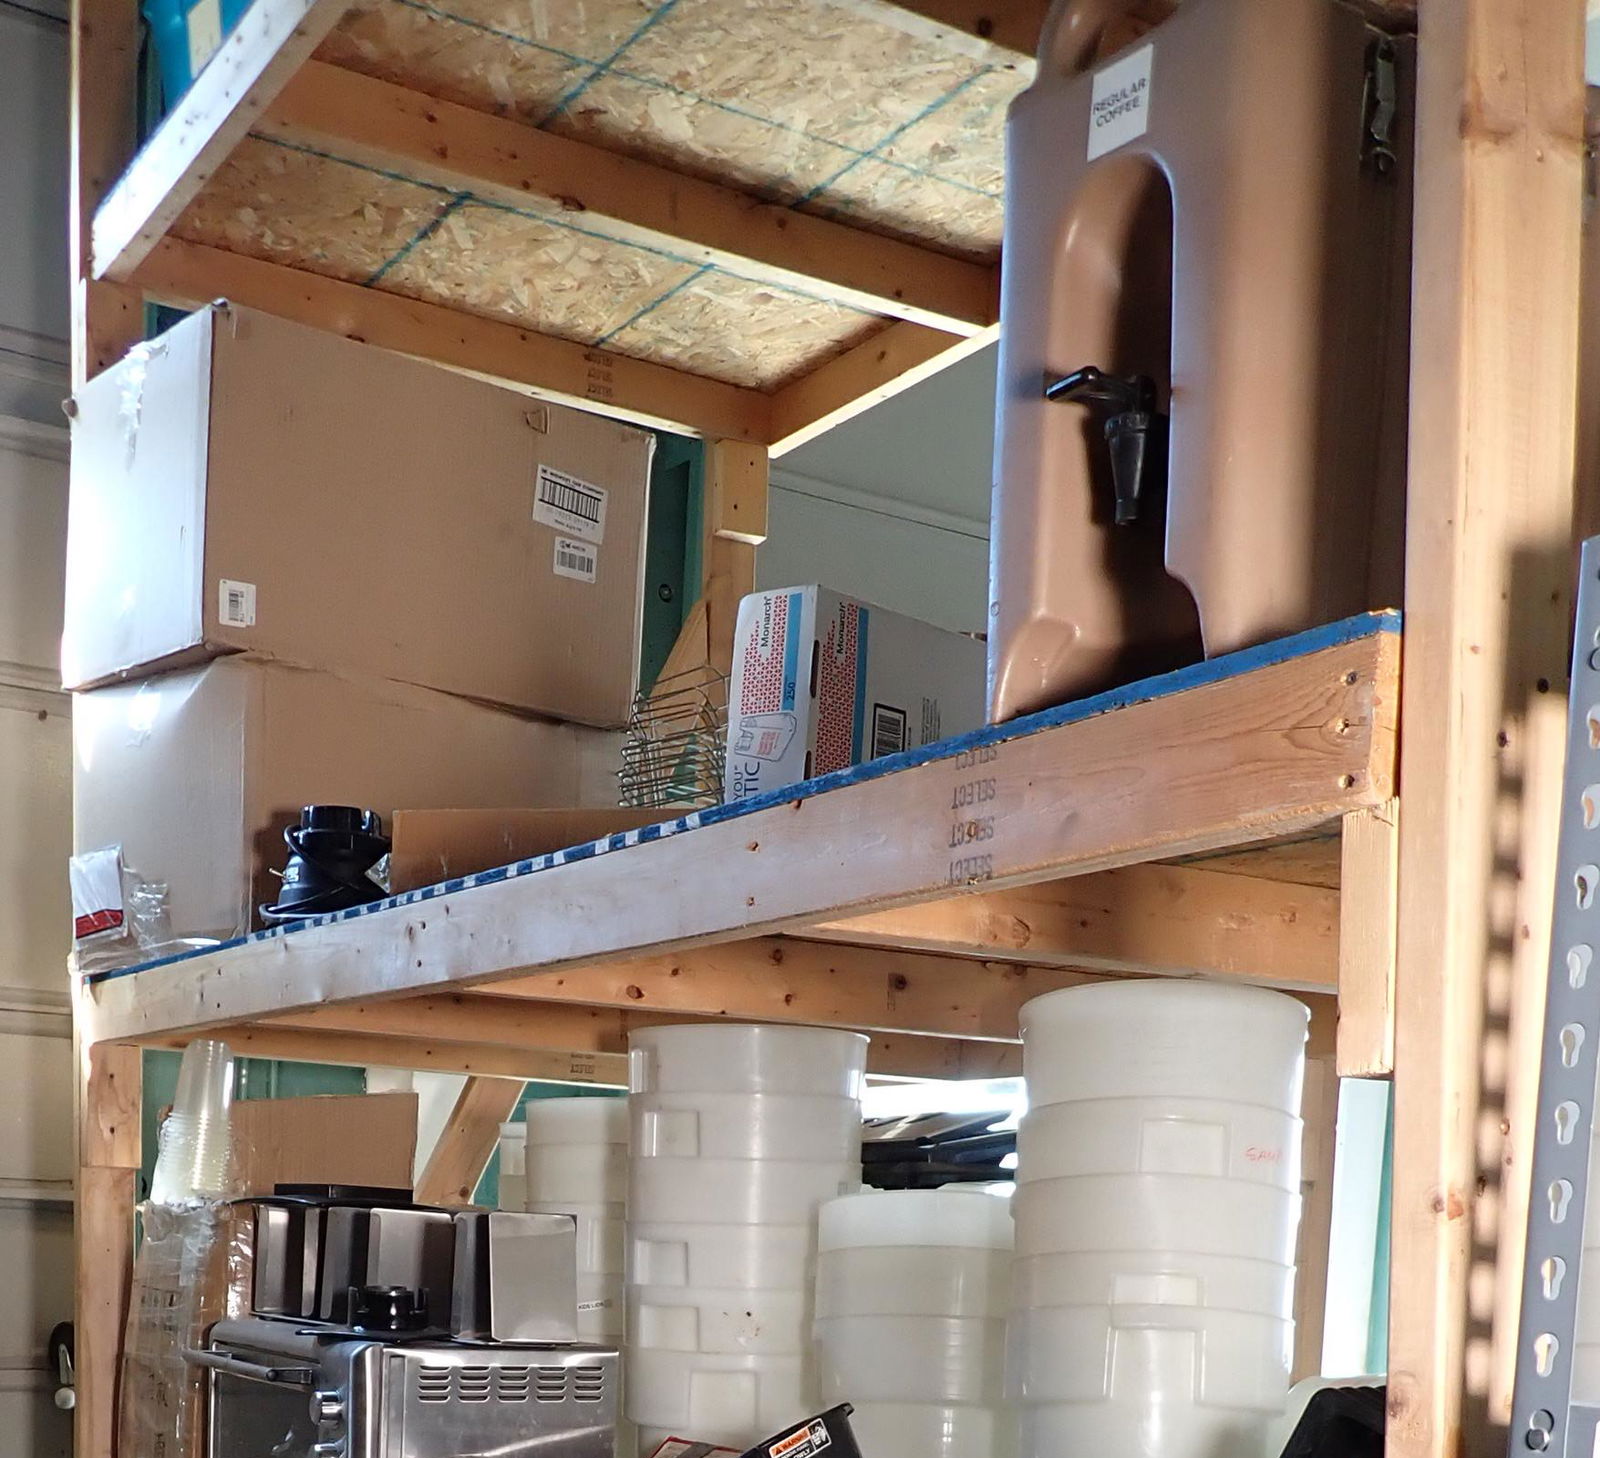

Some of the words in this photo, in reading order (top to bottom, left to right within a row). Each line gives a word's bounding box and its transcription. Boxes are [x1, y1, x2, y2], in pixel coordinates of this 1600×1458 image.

[1093, 78, 1146, 115] REGULAR
[1096, 95, 1140, 127] COFFEE
[761, 596, 772, 648] Monarch
[786, 681, 796, 701] 250
[951, 778, 996, 809] SELECT
